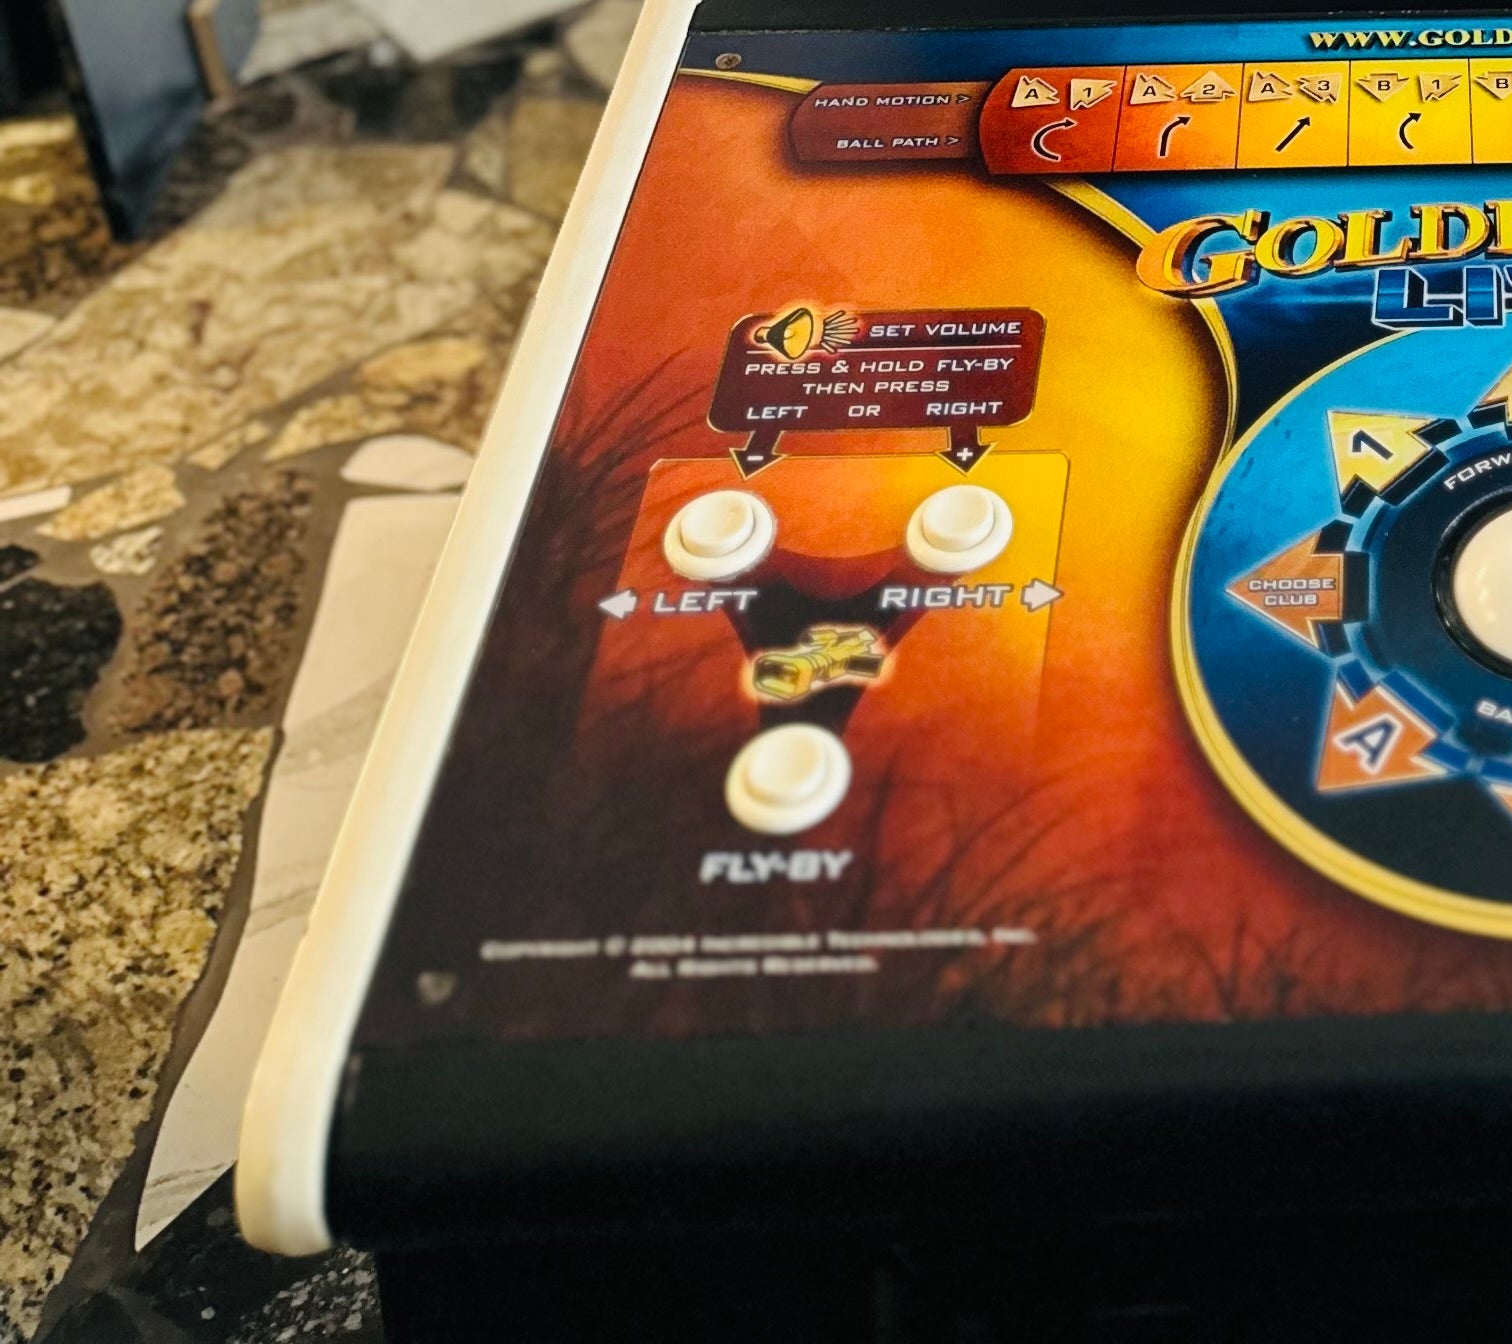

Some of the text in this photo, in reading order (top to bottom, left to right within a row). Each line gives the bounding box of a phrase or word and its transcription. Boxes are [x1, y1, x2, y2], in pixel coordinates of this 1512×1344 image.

[815, 93, 951, 109] HAND MOTION
[836, 135, 939, 149] BALL PATH
[869, 321, 1022, 337] SET VOLUME
[744, 357, 1014, 375] PRESS & HOLD FLY-BY
[802, 379, 950, 395] THEN PRESS
[746, 401, 1003, 420] LEFT OR RIGHT
[1349, 427, 1396, 467] 1
[1248, 577, 1336, 592] CHOOSE
[653, 584, 1012, 614] LEFT RIGHT
[1263, 592, 1318, 607] CLUB
[1342, 713, 1402, 774] A
[699, 850, 856, 885] FLY-BY
